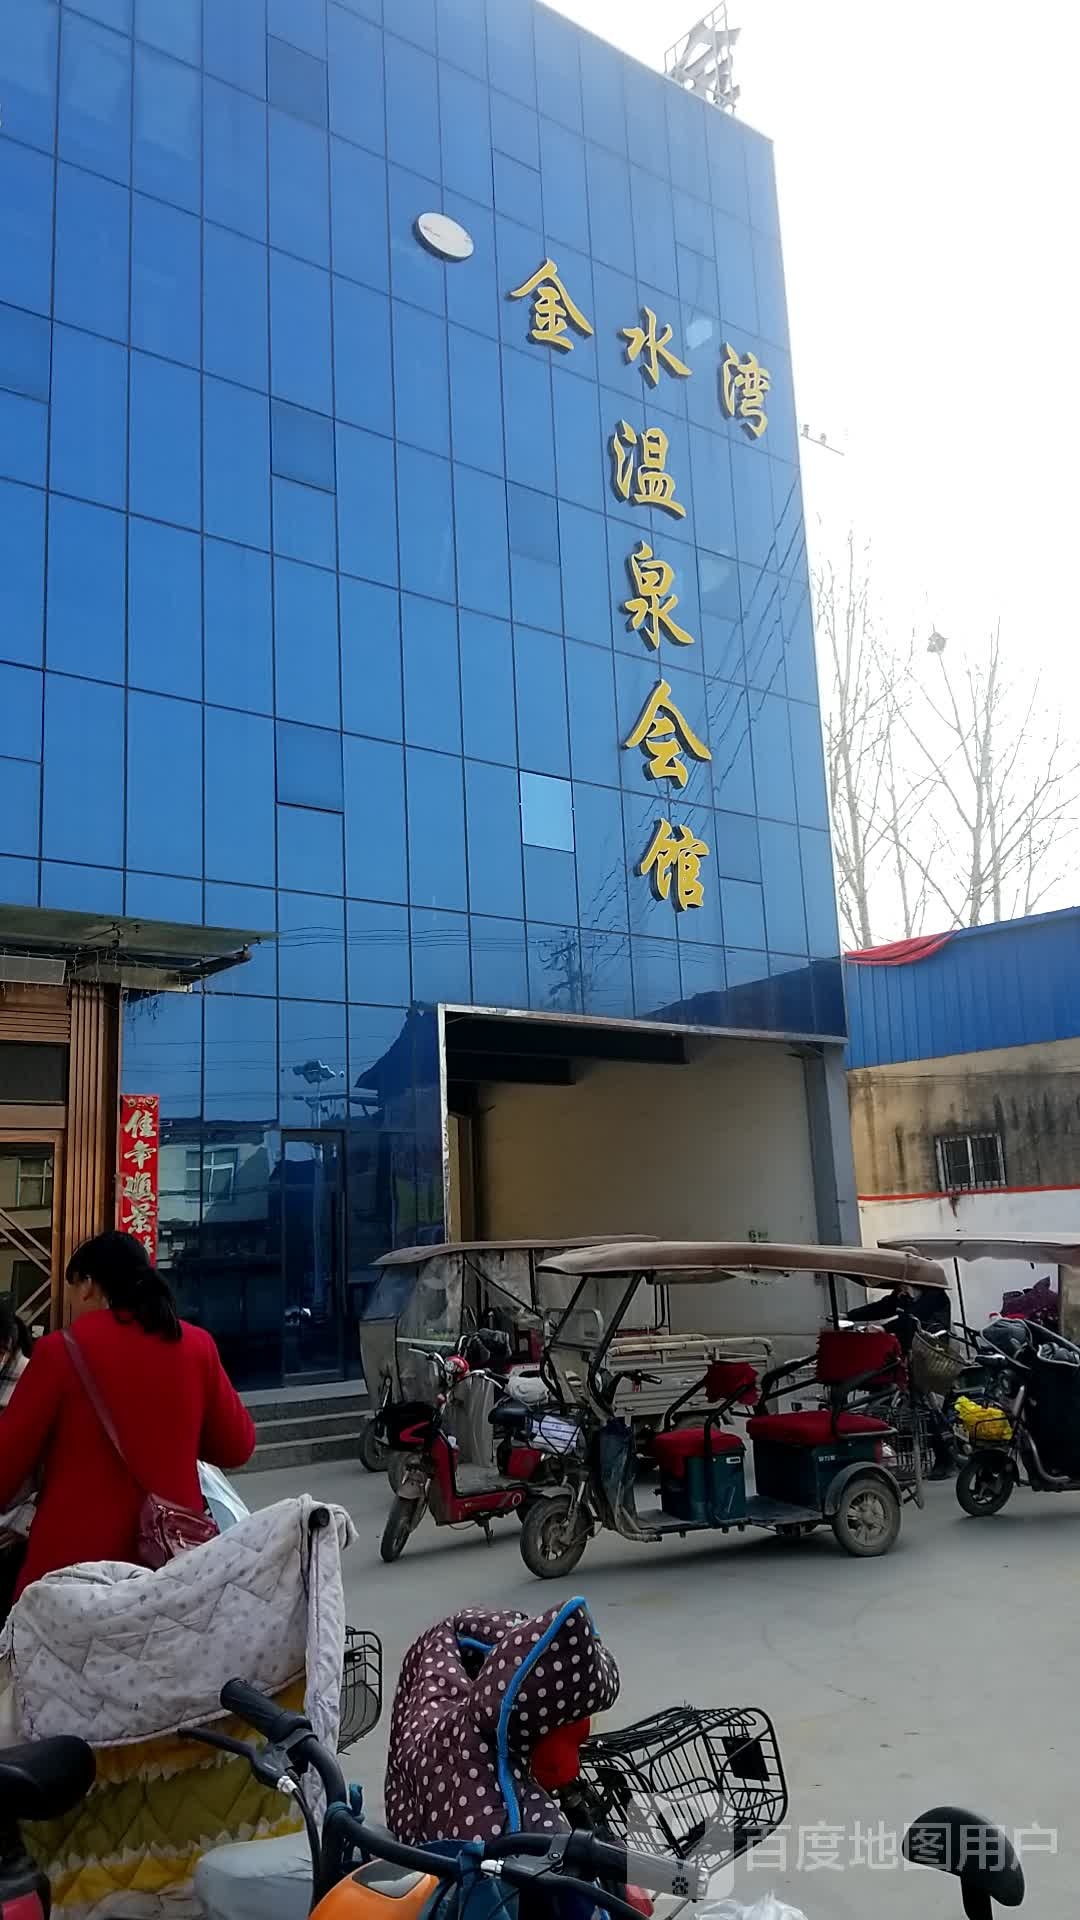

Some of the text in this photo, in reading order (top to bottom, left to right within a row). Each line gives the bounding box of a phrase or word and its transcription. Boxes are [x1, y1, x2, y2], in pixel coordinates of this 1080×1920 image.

[509, 257, 771, 439] 金水湾
[612, 419, 711, 912] 温泉会馆
